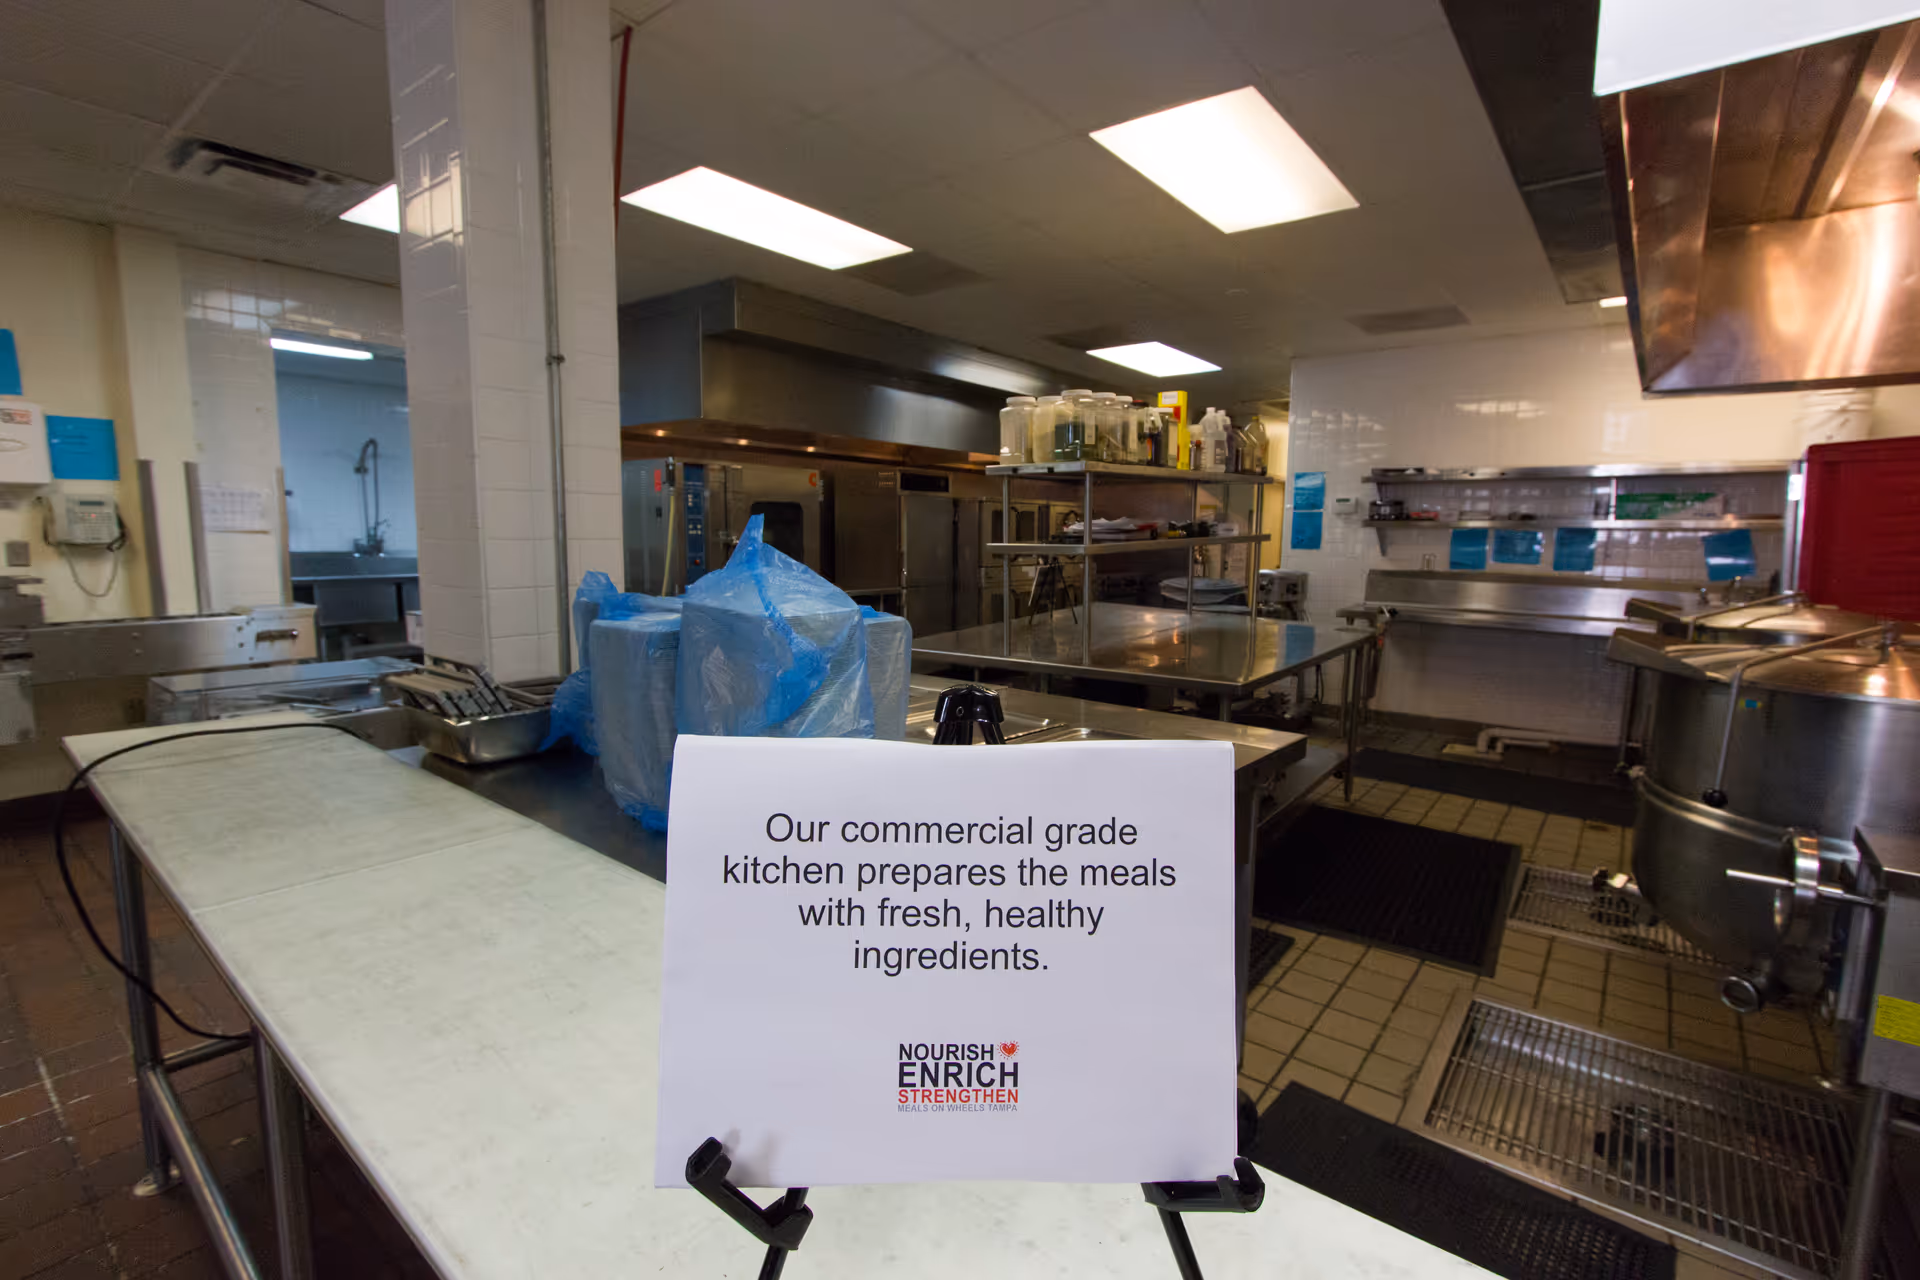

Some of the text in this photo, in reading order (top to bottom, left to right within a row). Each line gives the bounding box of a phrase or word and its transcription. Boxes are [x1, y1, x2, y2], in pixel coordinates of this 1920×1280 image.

[766, 813, 1137, 852] Our commercial grade
[724, 855, 1176, 892] kitchen prepares the meals
[798, 897, 1104, 936] with fresh, healthy
[855, 940, 1047, 977] ingredients.
[899, 1043, 994, 1061] NOURISH
[898, 1061, 1019, 1088] ENRICH
[897, 1104, 1018, 1113] MEALS ON WHEELS TAMPA
[898, 1088, 1018, 1104] STRENGTHEN
